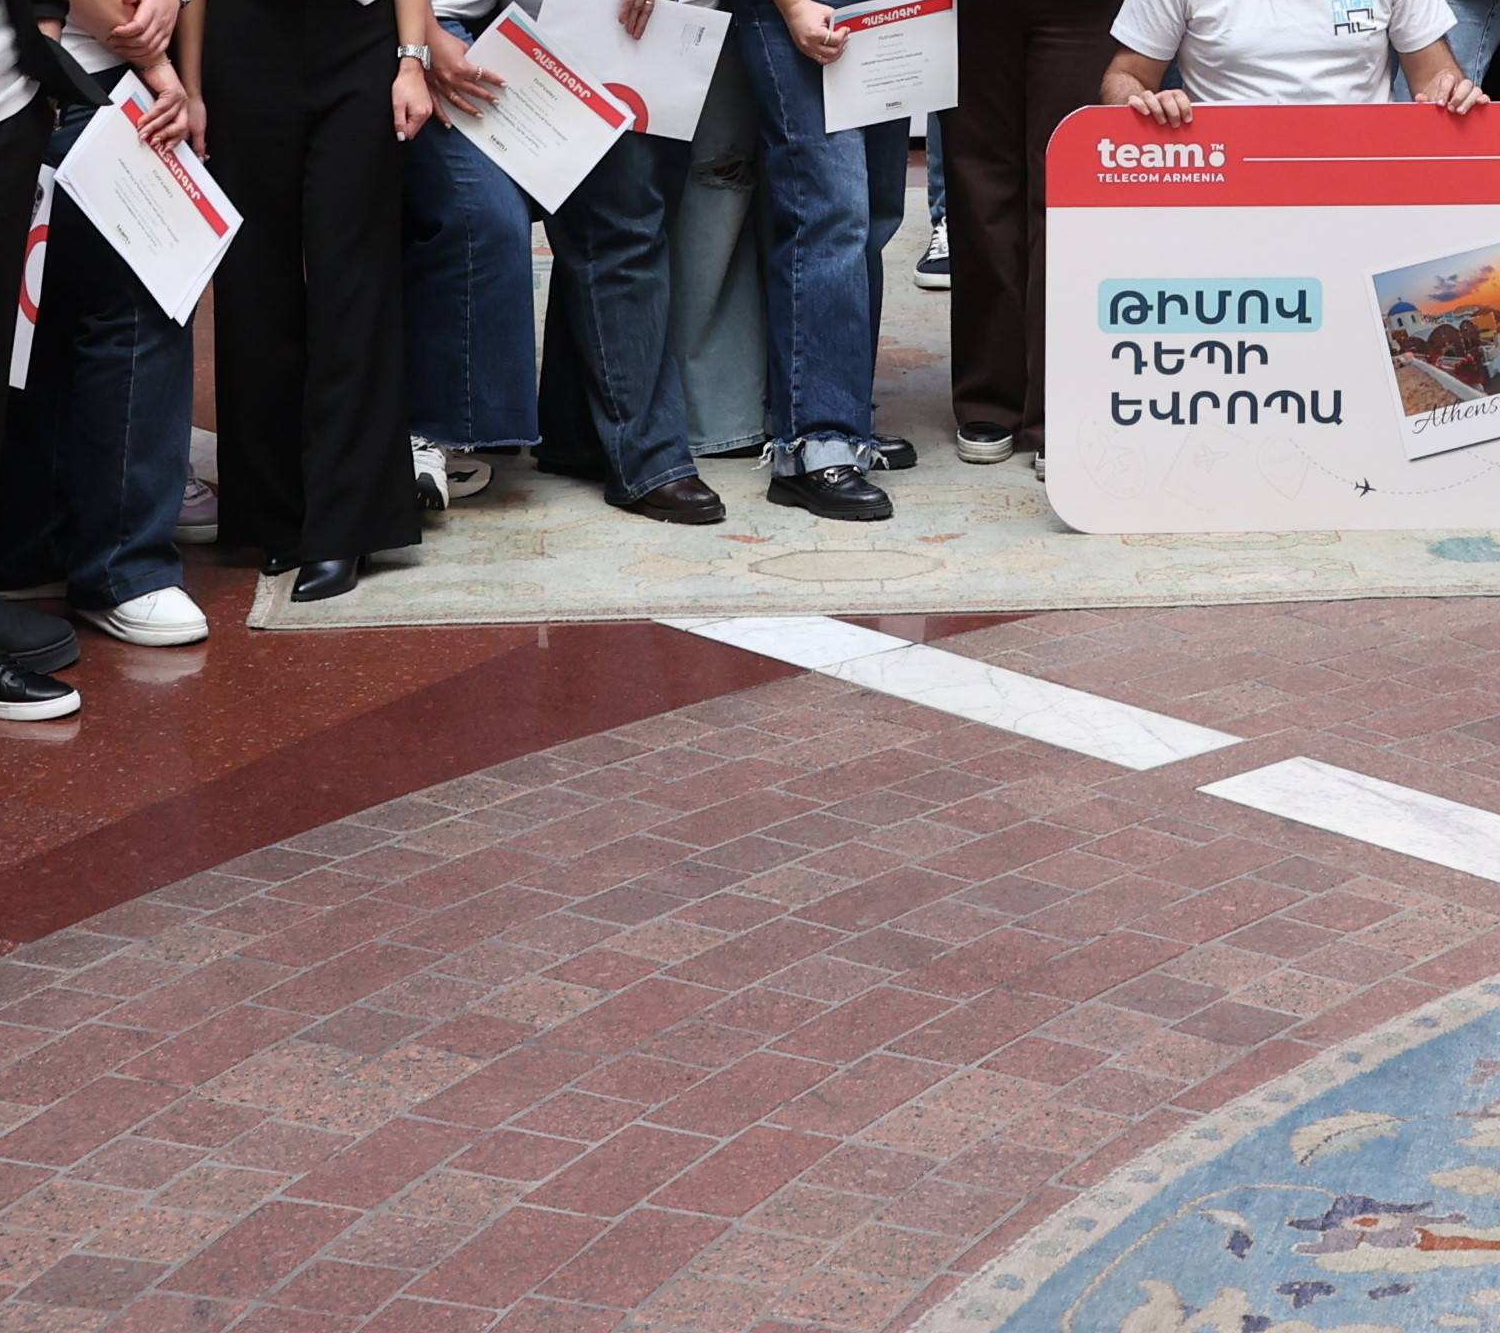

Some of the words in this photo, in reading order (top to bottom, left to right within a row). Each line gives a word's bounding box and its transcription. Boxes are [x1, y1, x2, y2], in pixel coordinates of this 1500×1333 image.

[1097, 138, 1205, 168] team
[1097, 173, 1159, 183] TELECOM
[1163, 173, 1225, 183] ARMENIA
[1110, 289, 1312, 325] ԹԻՄՈՎ
[1111, 340, 1268, 375] ԴԵՊԻ
[1111, 389, 1343, 426] ԵՎՐՈՊԱ
[1412, 396, 1500, 434] Athens
